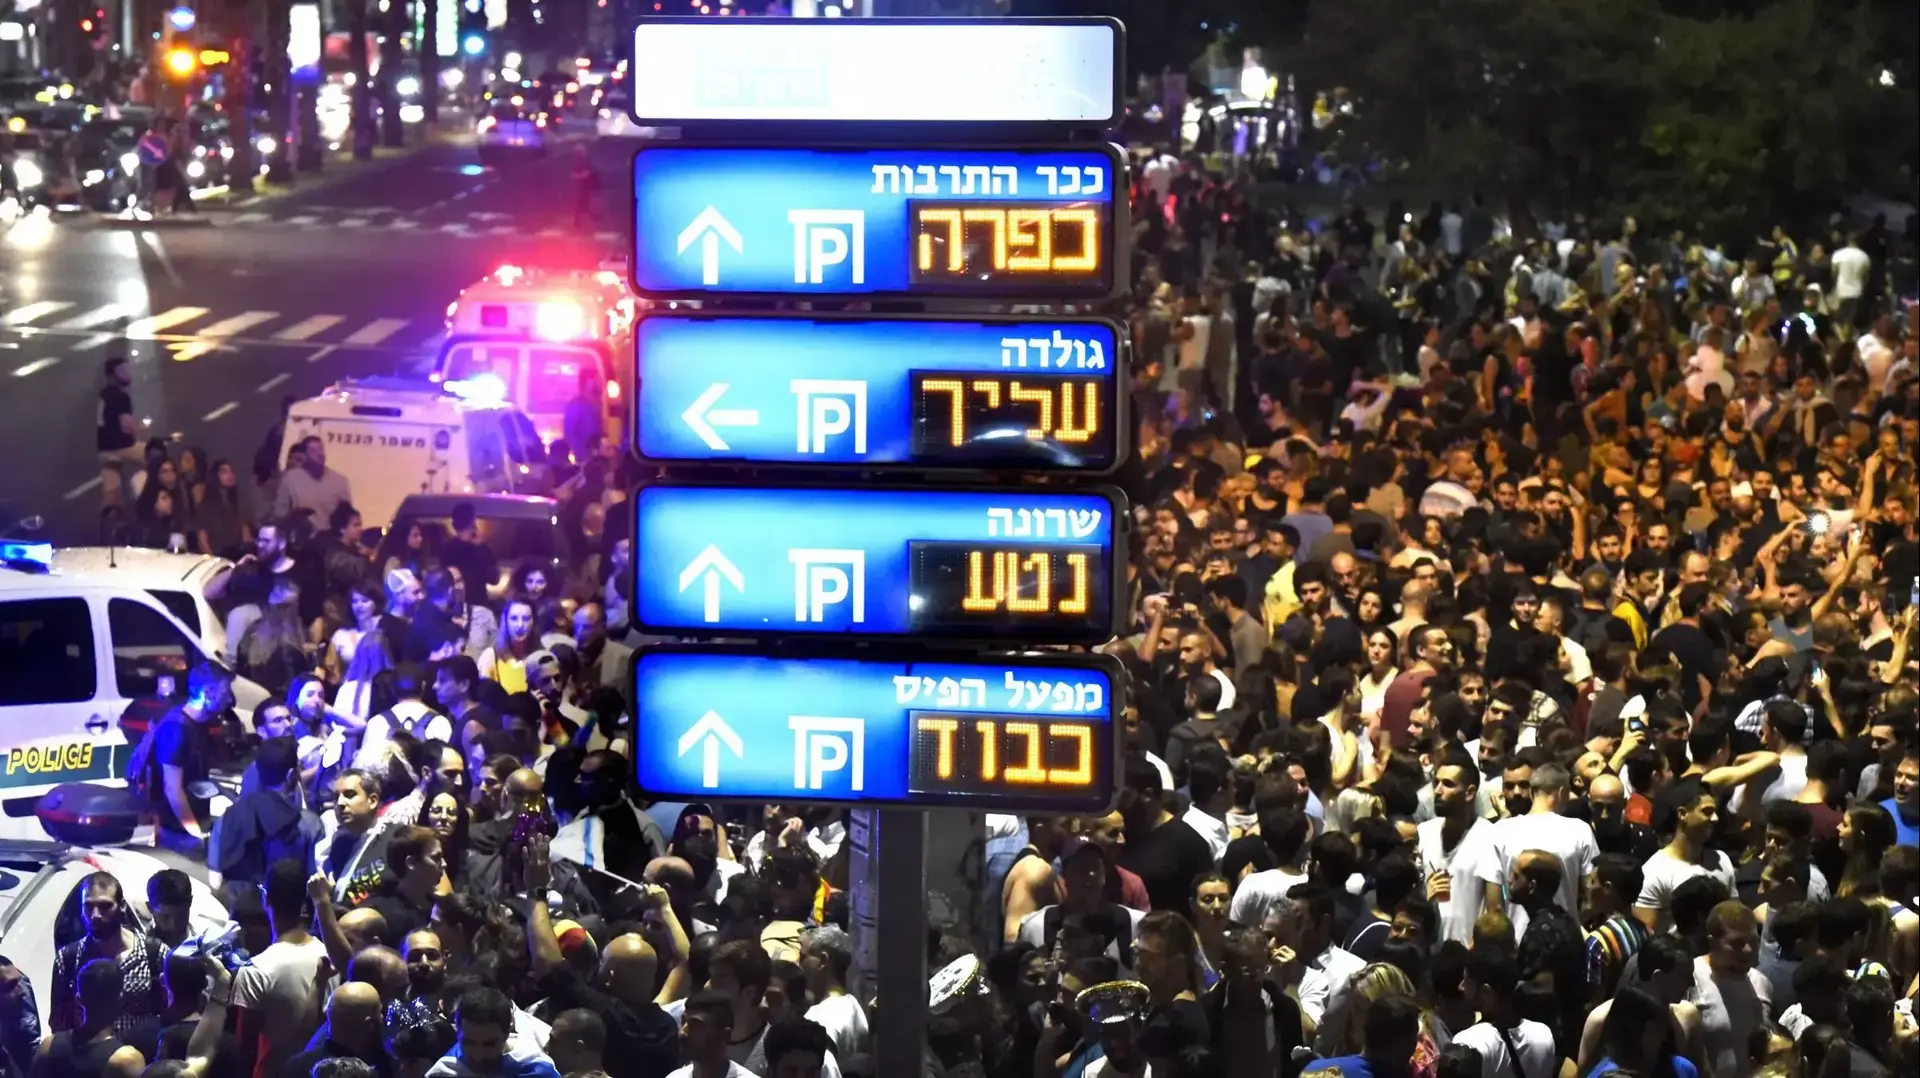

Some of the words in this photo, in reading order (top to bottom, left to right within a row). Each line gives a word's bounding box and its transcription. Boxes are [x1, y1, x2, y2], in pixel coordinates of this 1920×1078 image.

[870, 164, 1018, 195] התרבות
[1036, 165, 1103, 195] ככר
[918, 208, 1098, 273] כפרה
[1001, 330, 1105, 369] גולדה
[922, 379, 1097, 447] עליך
[327, 431, 374, 444] הגבול
[379, 435, 426, 448] משמר
[987, 507, 1102, 538] שרונה
[962, 551, 1087, 613] נטע
[892, 674, 987, 707] הפיס
[1004, 672, 1103, 711] מפעל
[6, 742, 93, 775] POLICE
[918, 718, 1092, 784] כבוד
